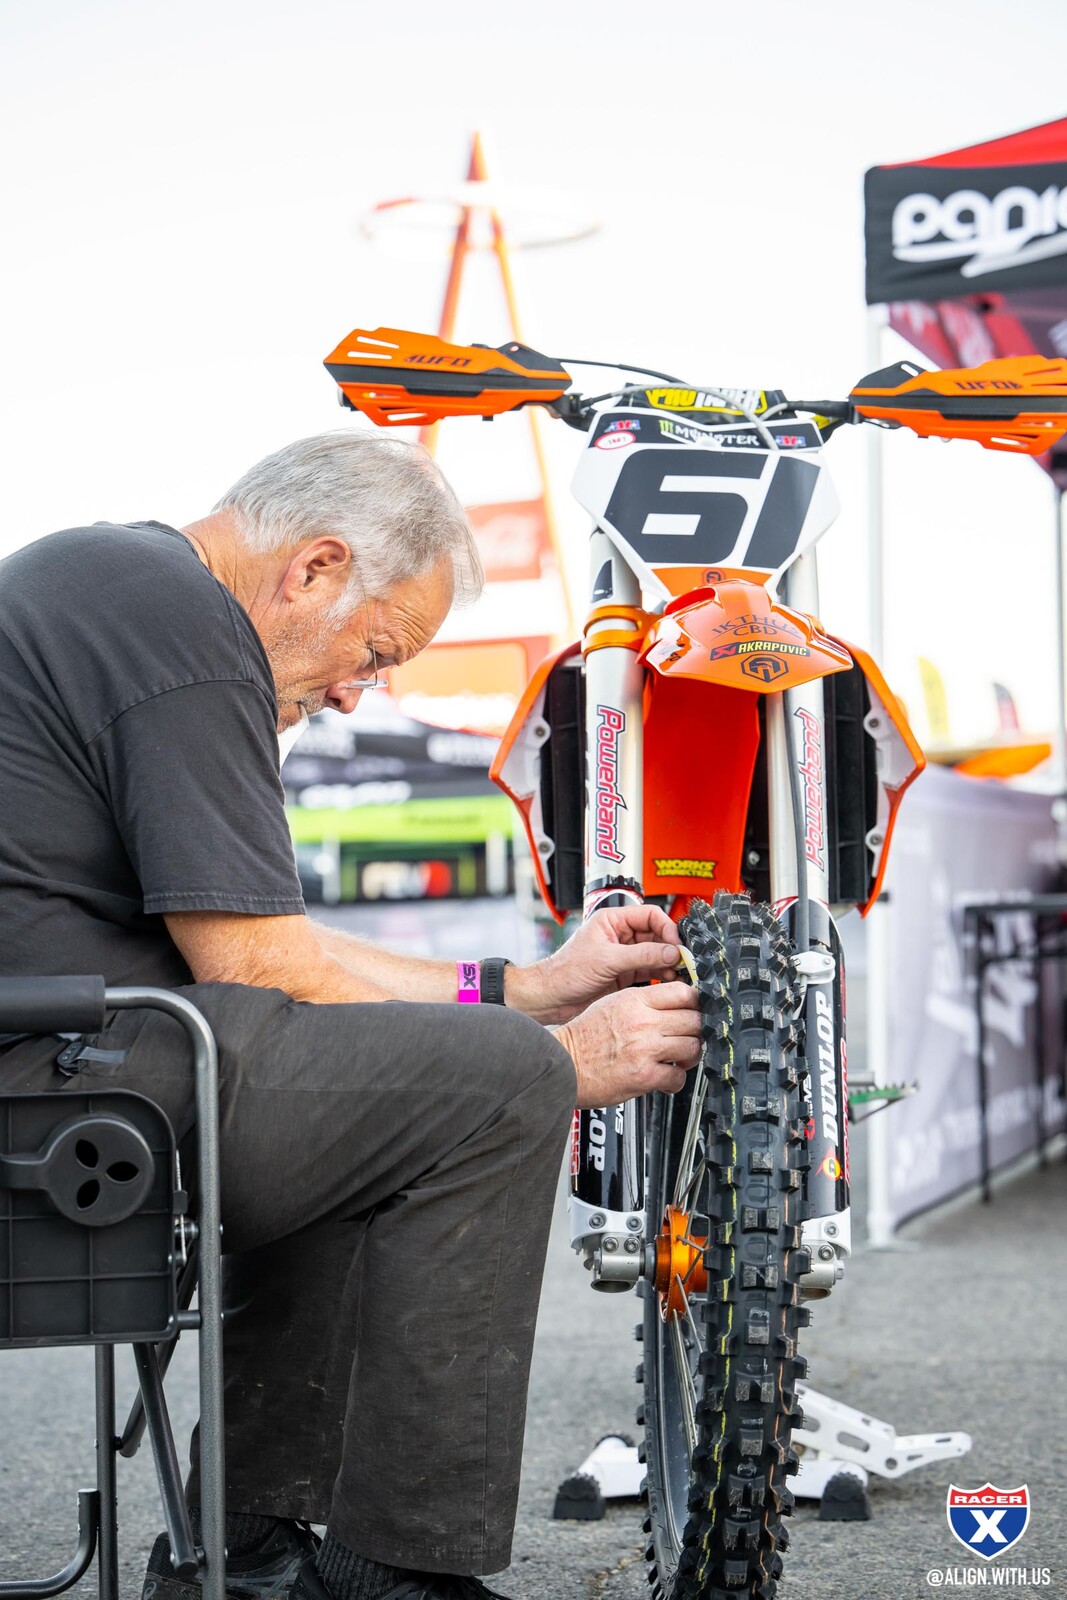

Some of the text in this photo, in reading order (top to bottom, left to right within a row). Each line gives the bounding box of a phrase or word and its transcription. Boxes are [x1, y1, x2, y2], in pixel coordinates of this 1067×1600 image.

[892, 185, 1067, 265] pani
[603, 448, 821, 569] 61
[733, 624, 778, 636] CBD
[596, 704, 628, 863] Powerband
[654, 858, 716, 871] WORKS
[463, 963, 477, 989] SX
[815, 990, 839, 1146] DUNLOP
